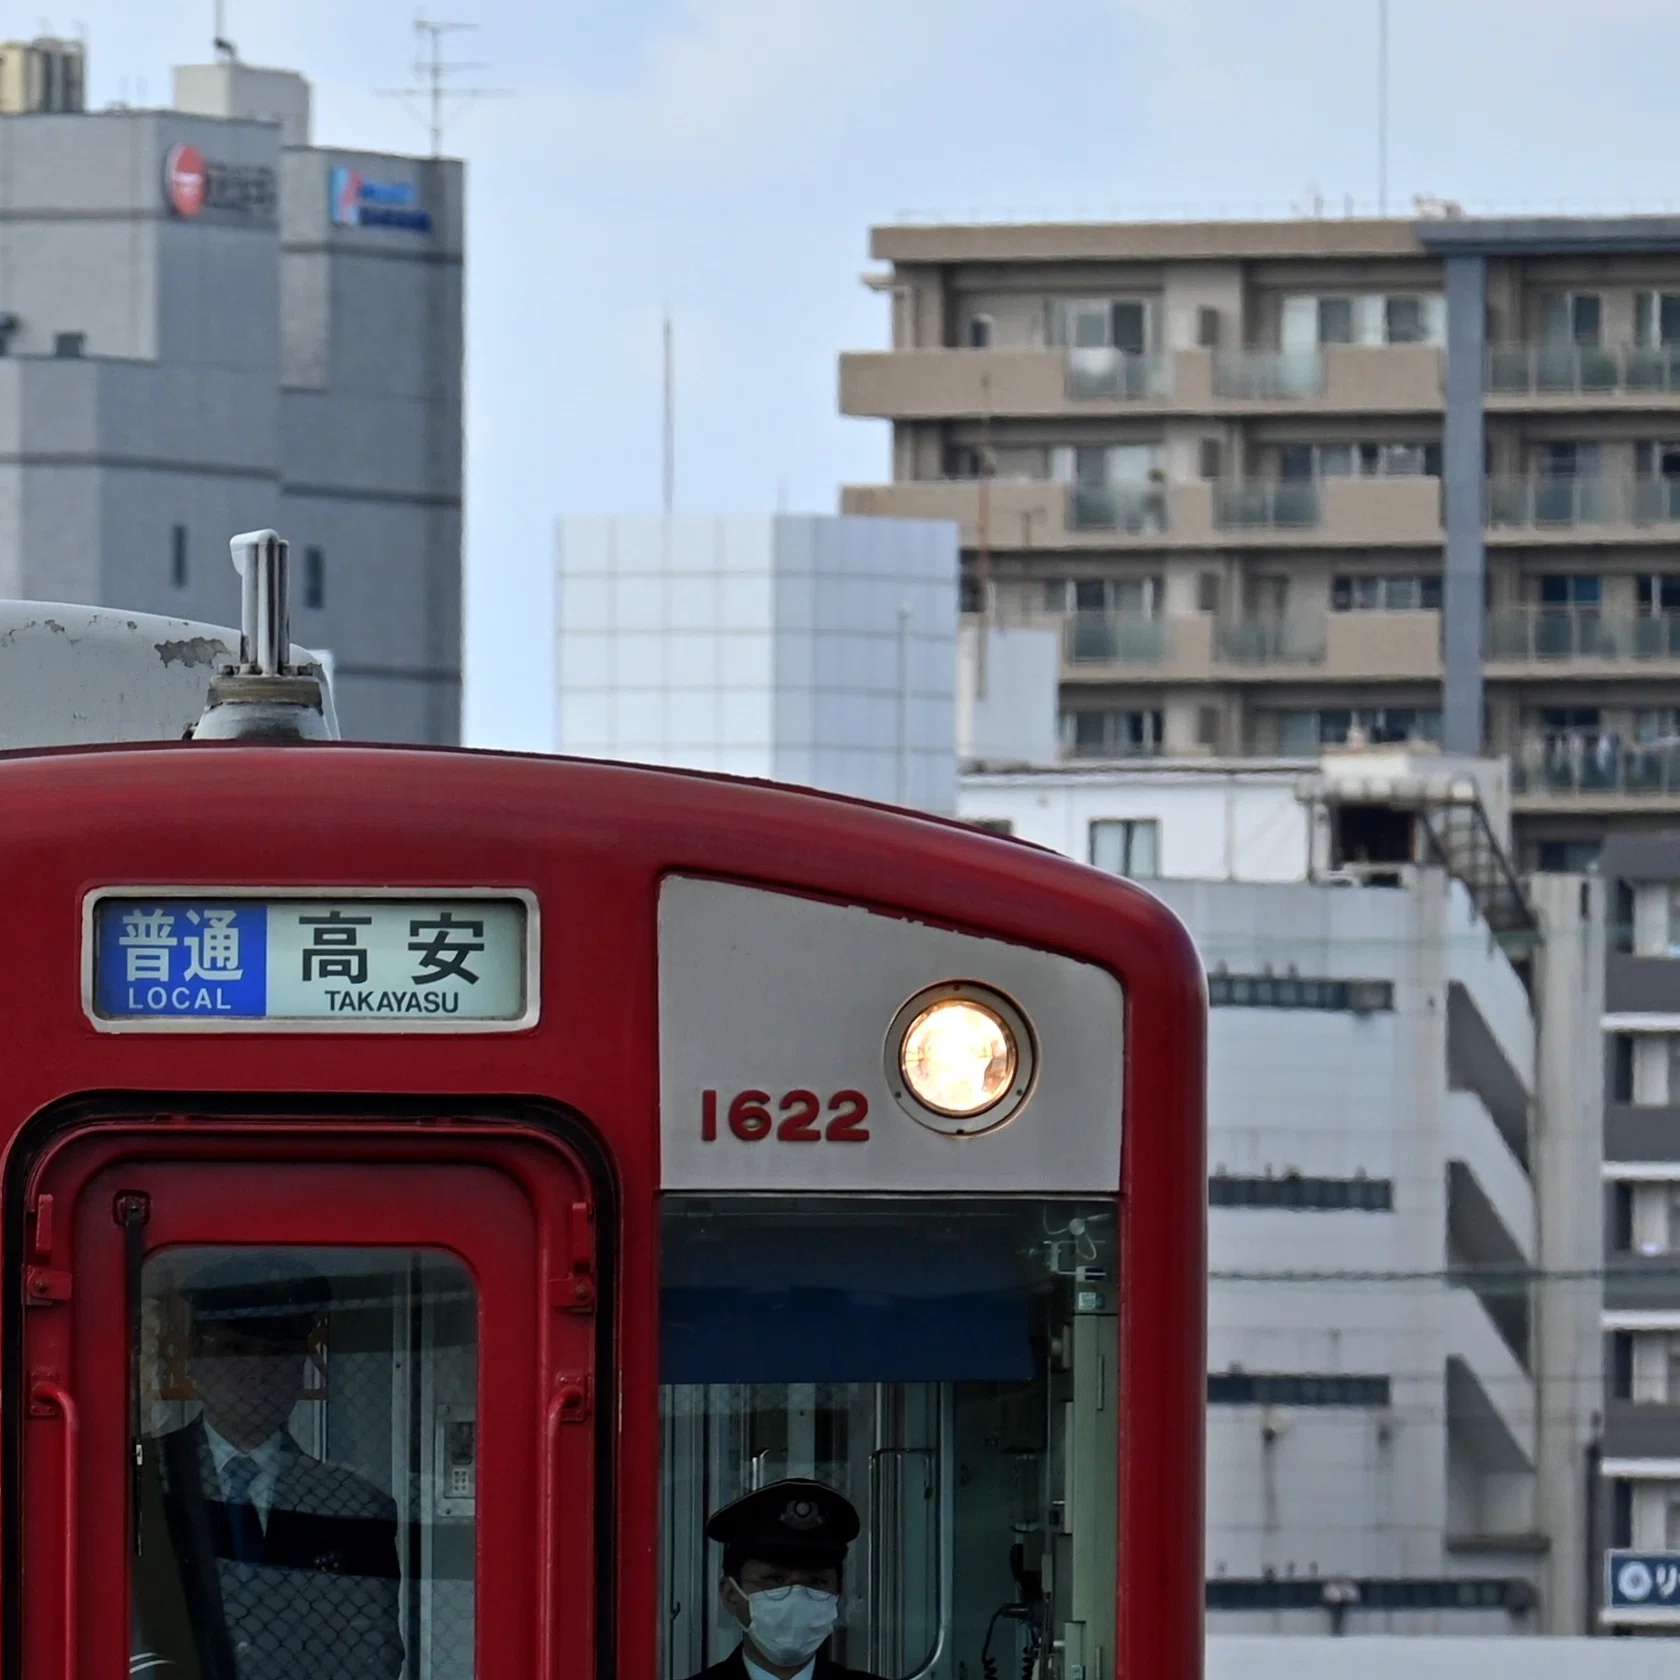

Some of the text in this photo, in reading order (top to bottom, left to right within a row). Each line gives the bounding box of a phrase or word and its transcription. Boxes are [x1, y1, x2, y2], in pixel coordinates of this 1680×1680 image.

[118, 908, 244, 983] 普通
[298, 911, 486, 986] 高安
[127, 986, 232, 1011] LOCAL
[324, 990, 460, 1014] TAKAYASU
[701, 1089, 870, 1142] 1622
